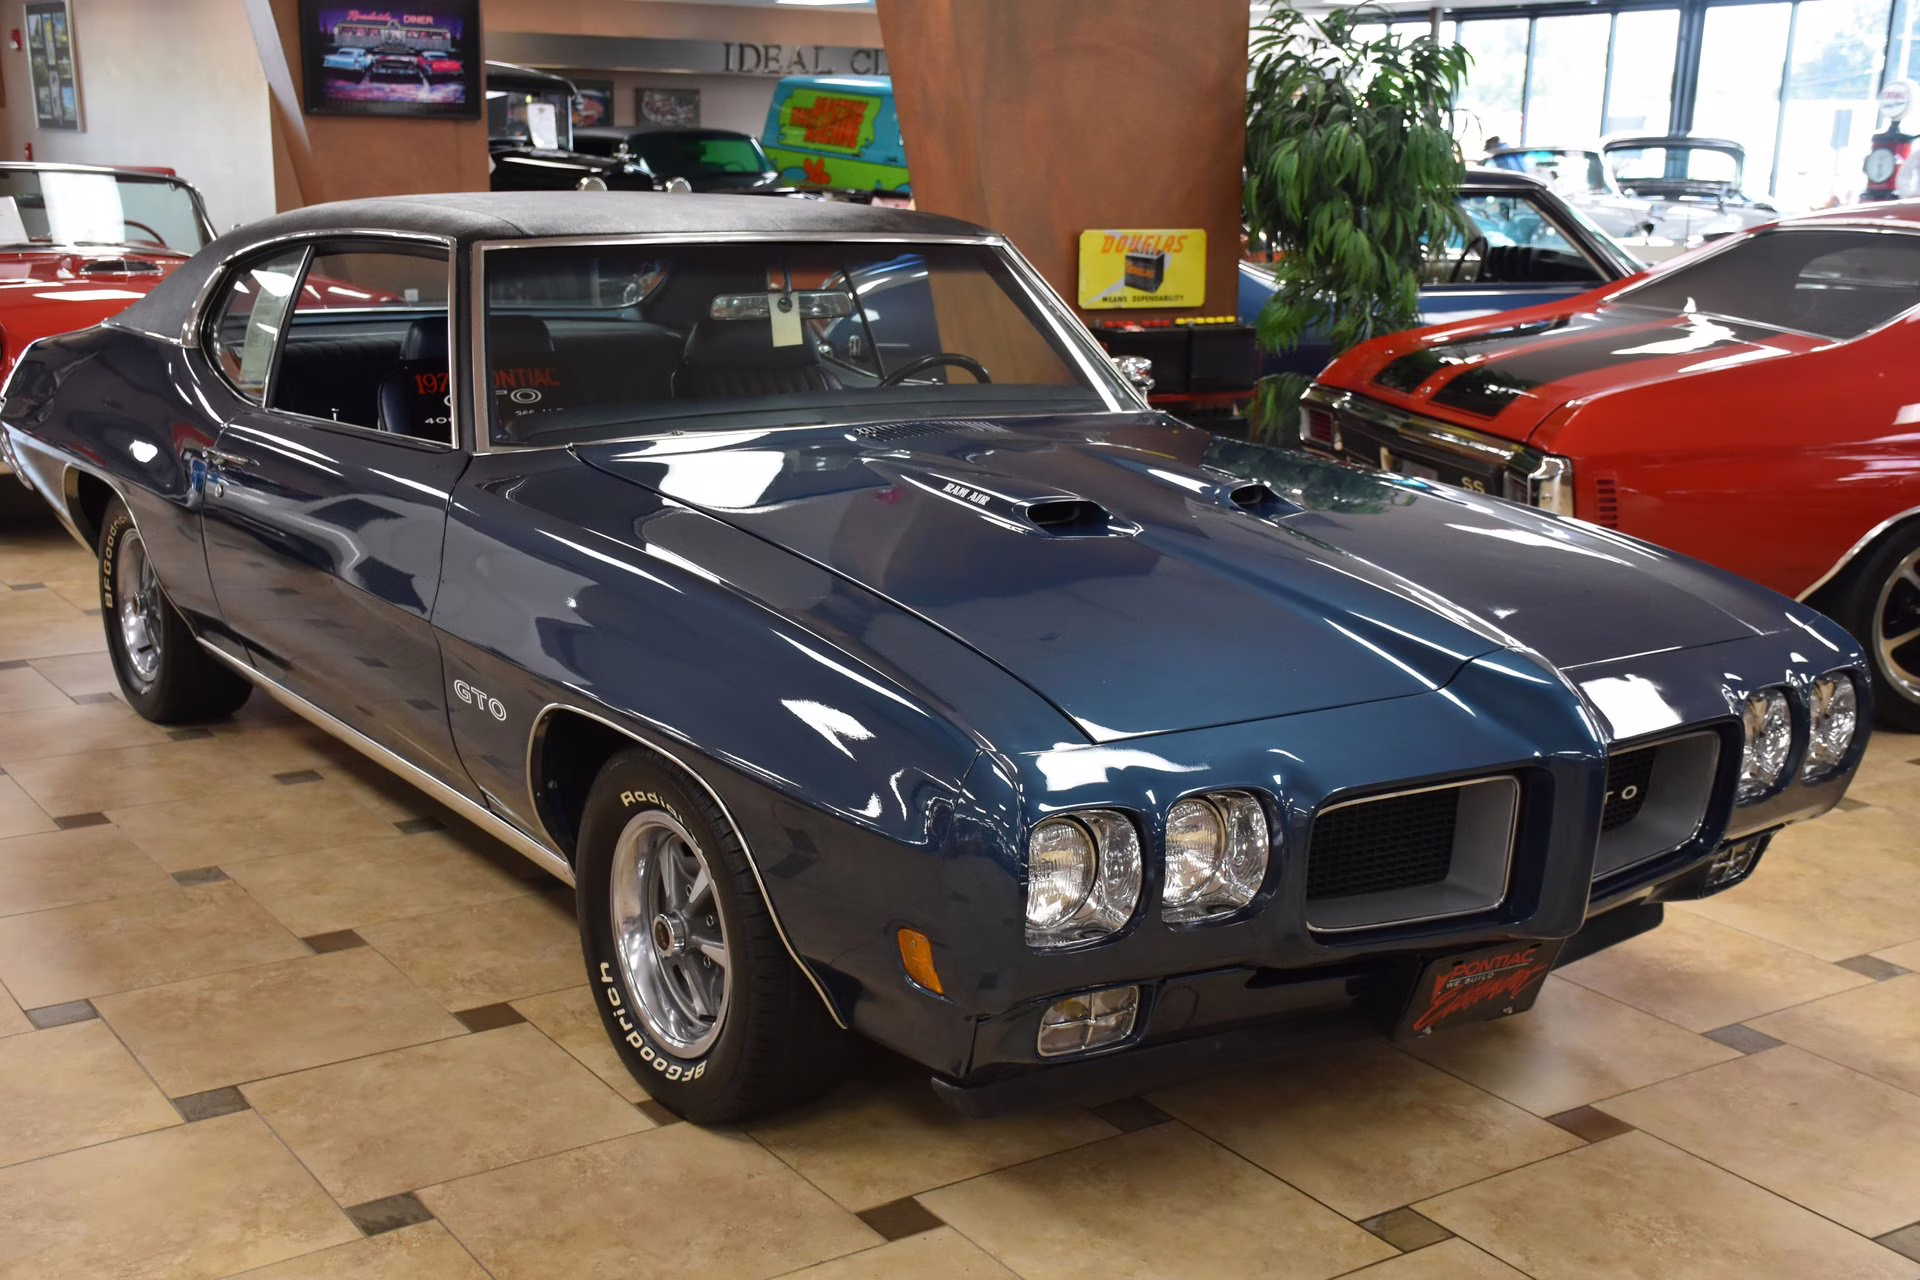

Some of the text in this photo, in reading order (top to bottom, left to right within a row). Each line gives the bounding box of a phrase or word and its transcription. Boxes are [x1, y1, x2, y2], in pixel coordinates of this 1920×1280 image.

[403, 14, 434, 25] DINER
[722, 42, 832, 75] IDEAL
[1100, 235, 1188, 255] DOUGLAS
[1131, 294, 1184, 303] DEPENDABILITY
[942, 482, 991, 506] RAM AIR
[1461, 476, 1486, 495] SS
[453, 679, 507, 722] GTO
[1450, 948, 1537, 978] PONTIAC
[1446, 972, 1495, 990] WE BUILD
[599, 961, 708, 1082] BFGoodrich
